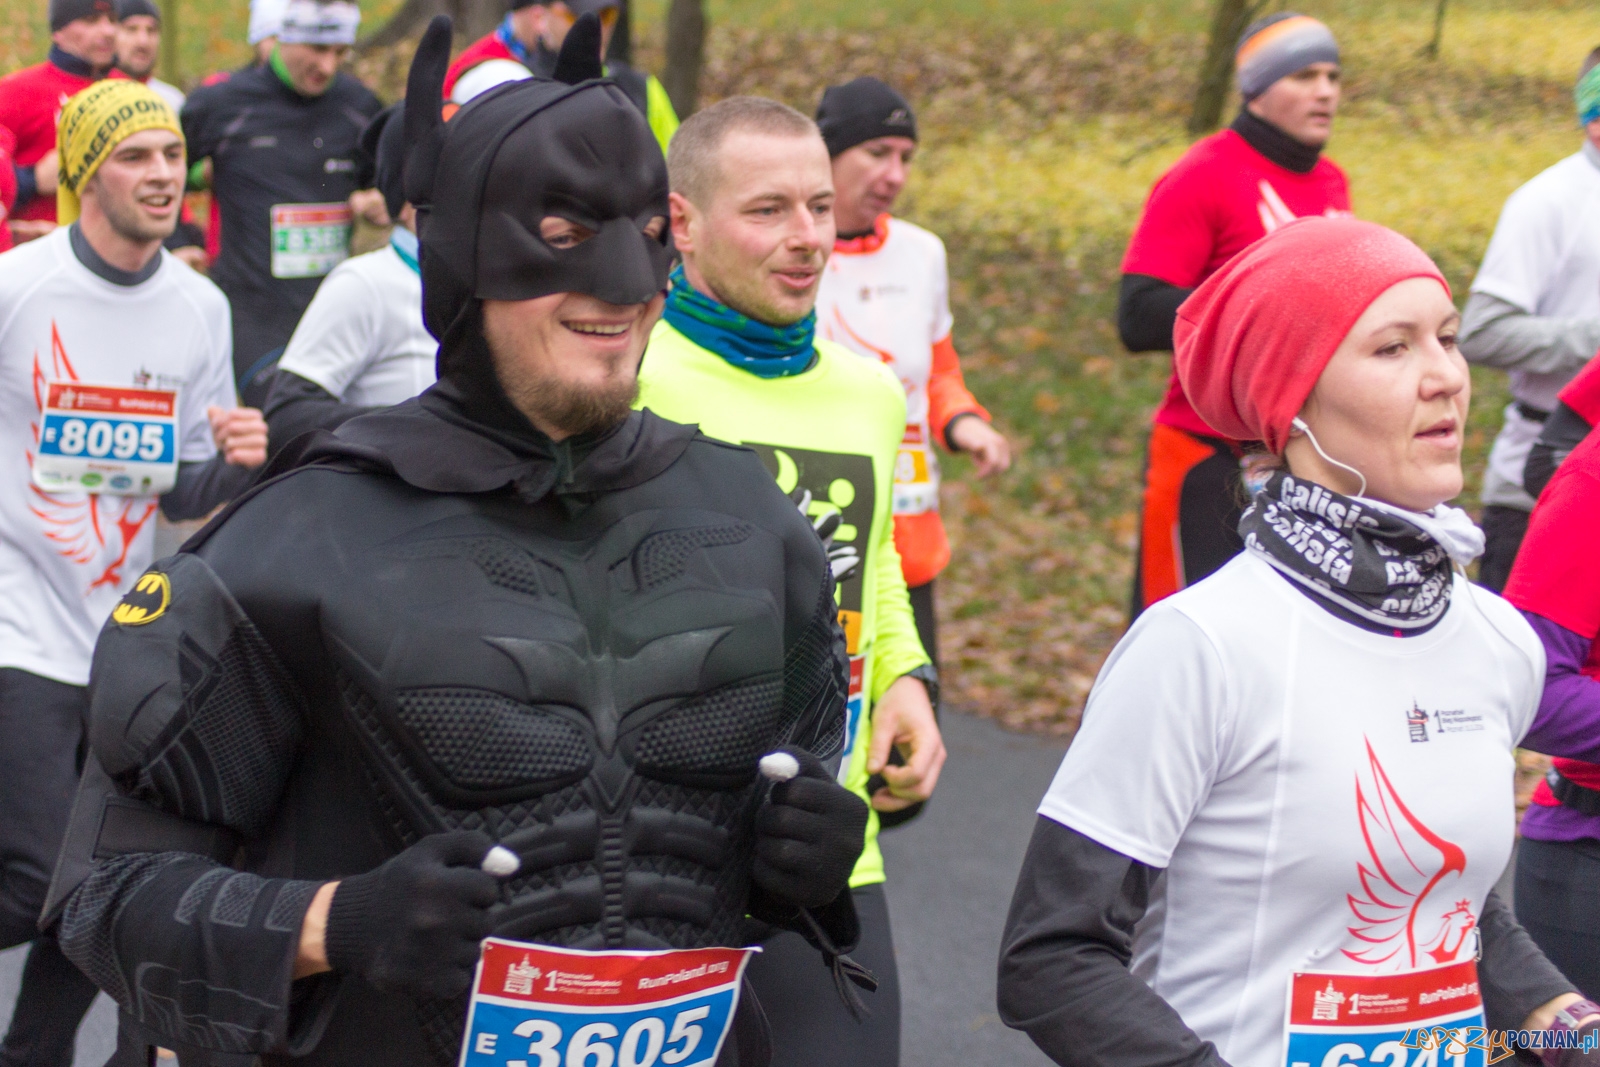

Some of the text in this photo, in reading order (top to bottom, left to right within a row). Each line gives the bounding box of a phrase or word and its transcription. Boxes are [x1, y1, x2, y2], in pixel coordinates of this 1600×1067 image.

[45, 419, 164, 461] E 8095
[637, 960, 730, 990] RunPoland.org
[475, 1005, 711, 1067] E 3605
